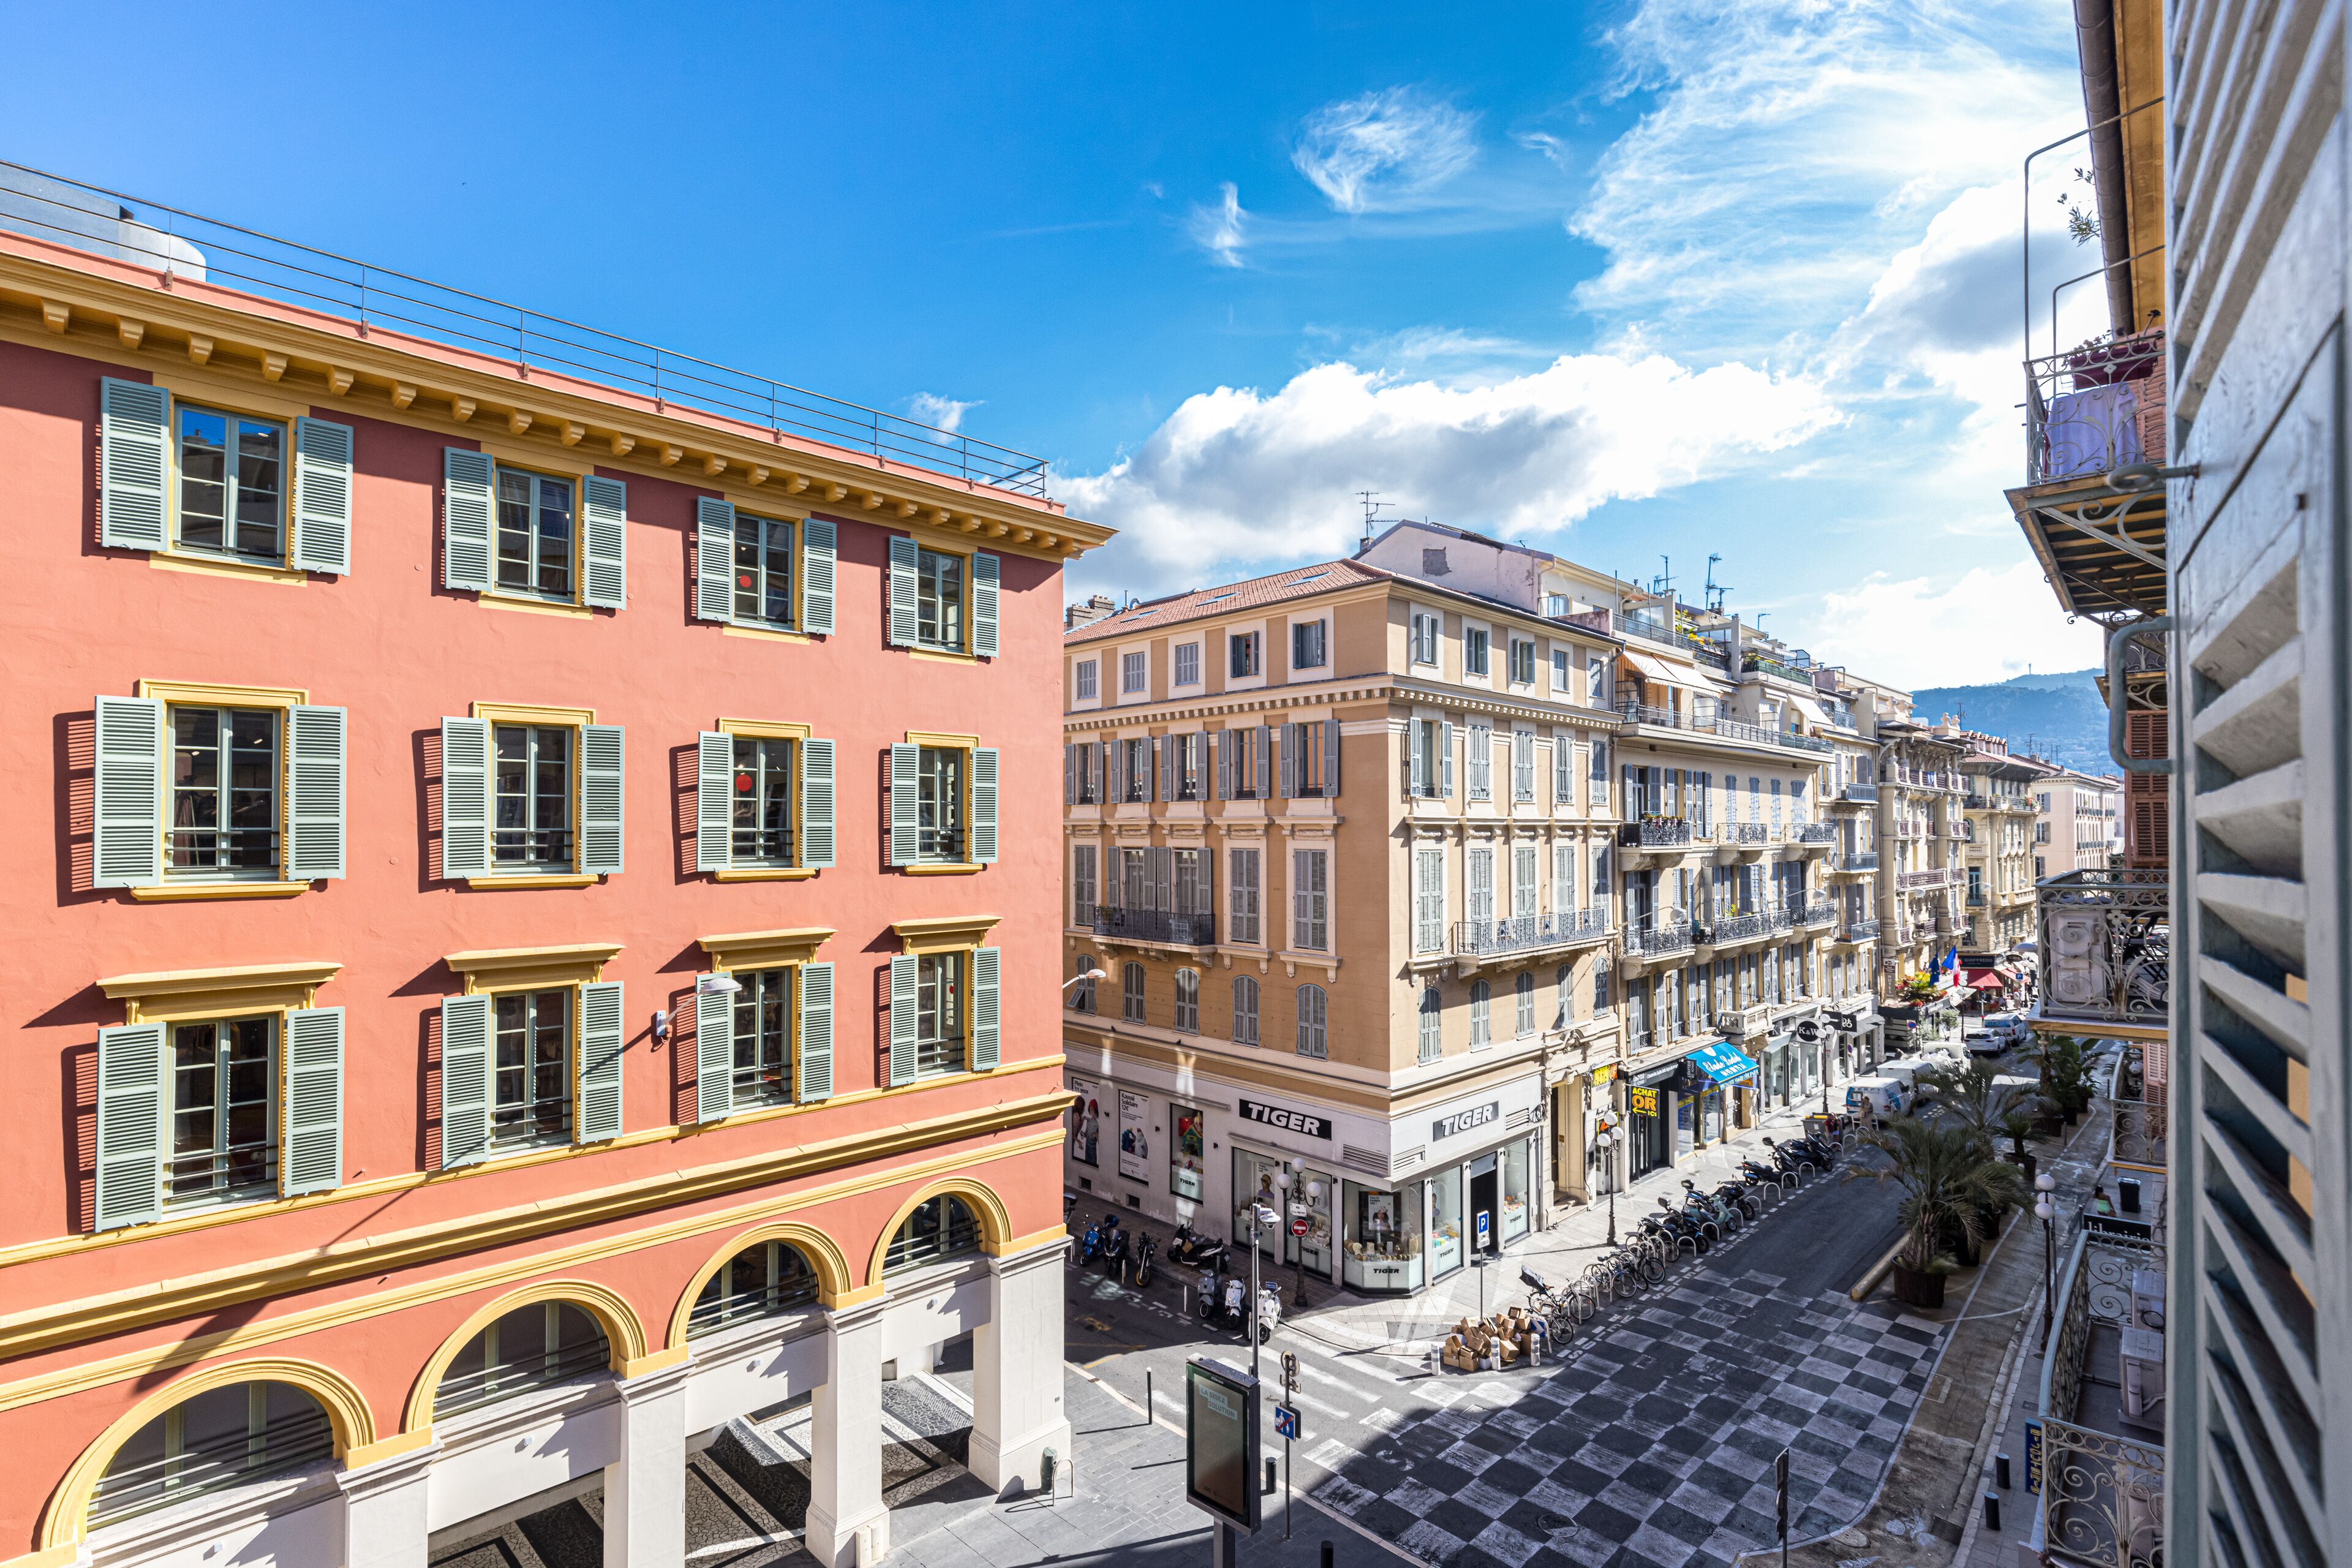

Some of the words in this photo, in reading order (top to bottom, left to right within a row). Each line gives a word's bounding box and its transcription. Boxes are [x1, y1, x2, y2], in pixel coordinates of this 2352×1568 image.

[1632, 1087, 1657, 1098] ACHAT
[1632, 1096, 1656, 1111] OR
[1249, 1102, 1320, 1135] TIGER
[1442, 1104, 1493, 1136] TIGER
[1180, 1178, 1196, 1187] TIGER
[1480, 1218, 1486, 1230] P
[2087, 1221, 2150, 1242] libii
[1440, 1248, 1454, 1257] TIGER
[1201, 1388, 1208, 1397] LA
[1209, 1391, 1226, 1403] SEULE
[1208, 1401, 1235, 1418] SOLUTION
